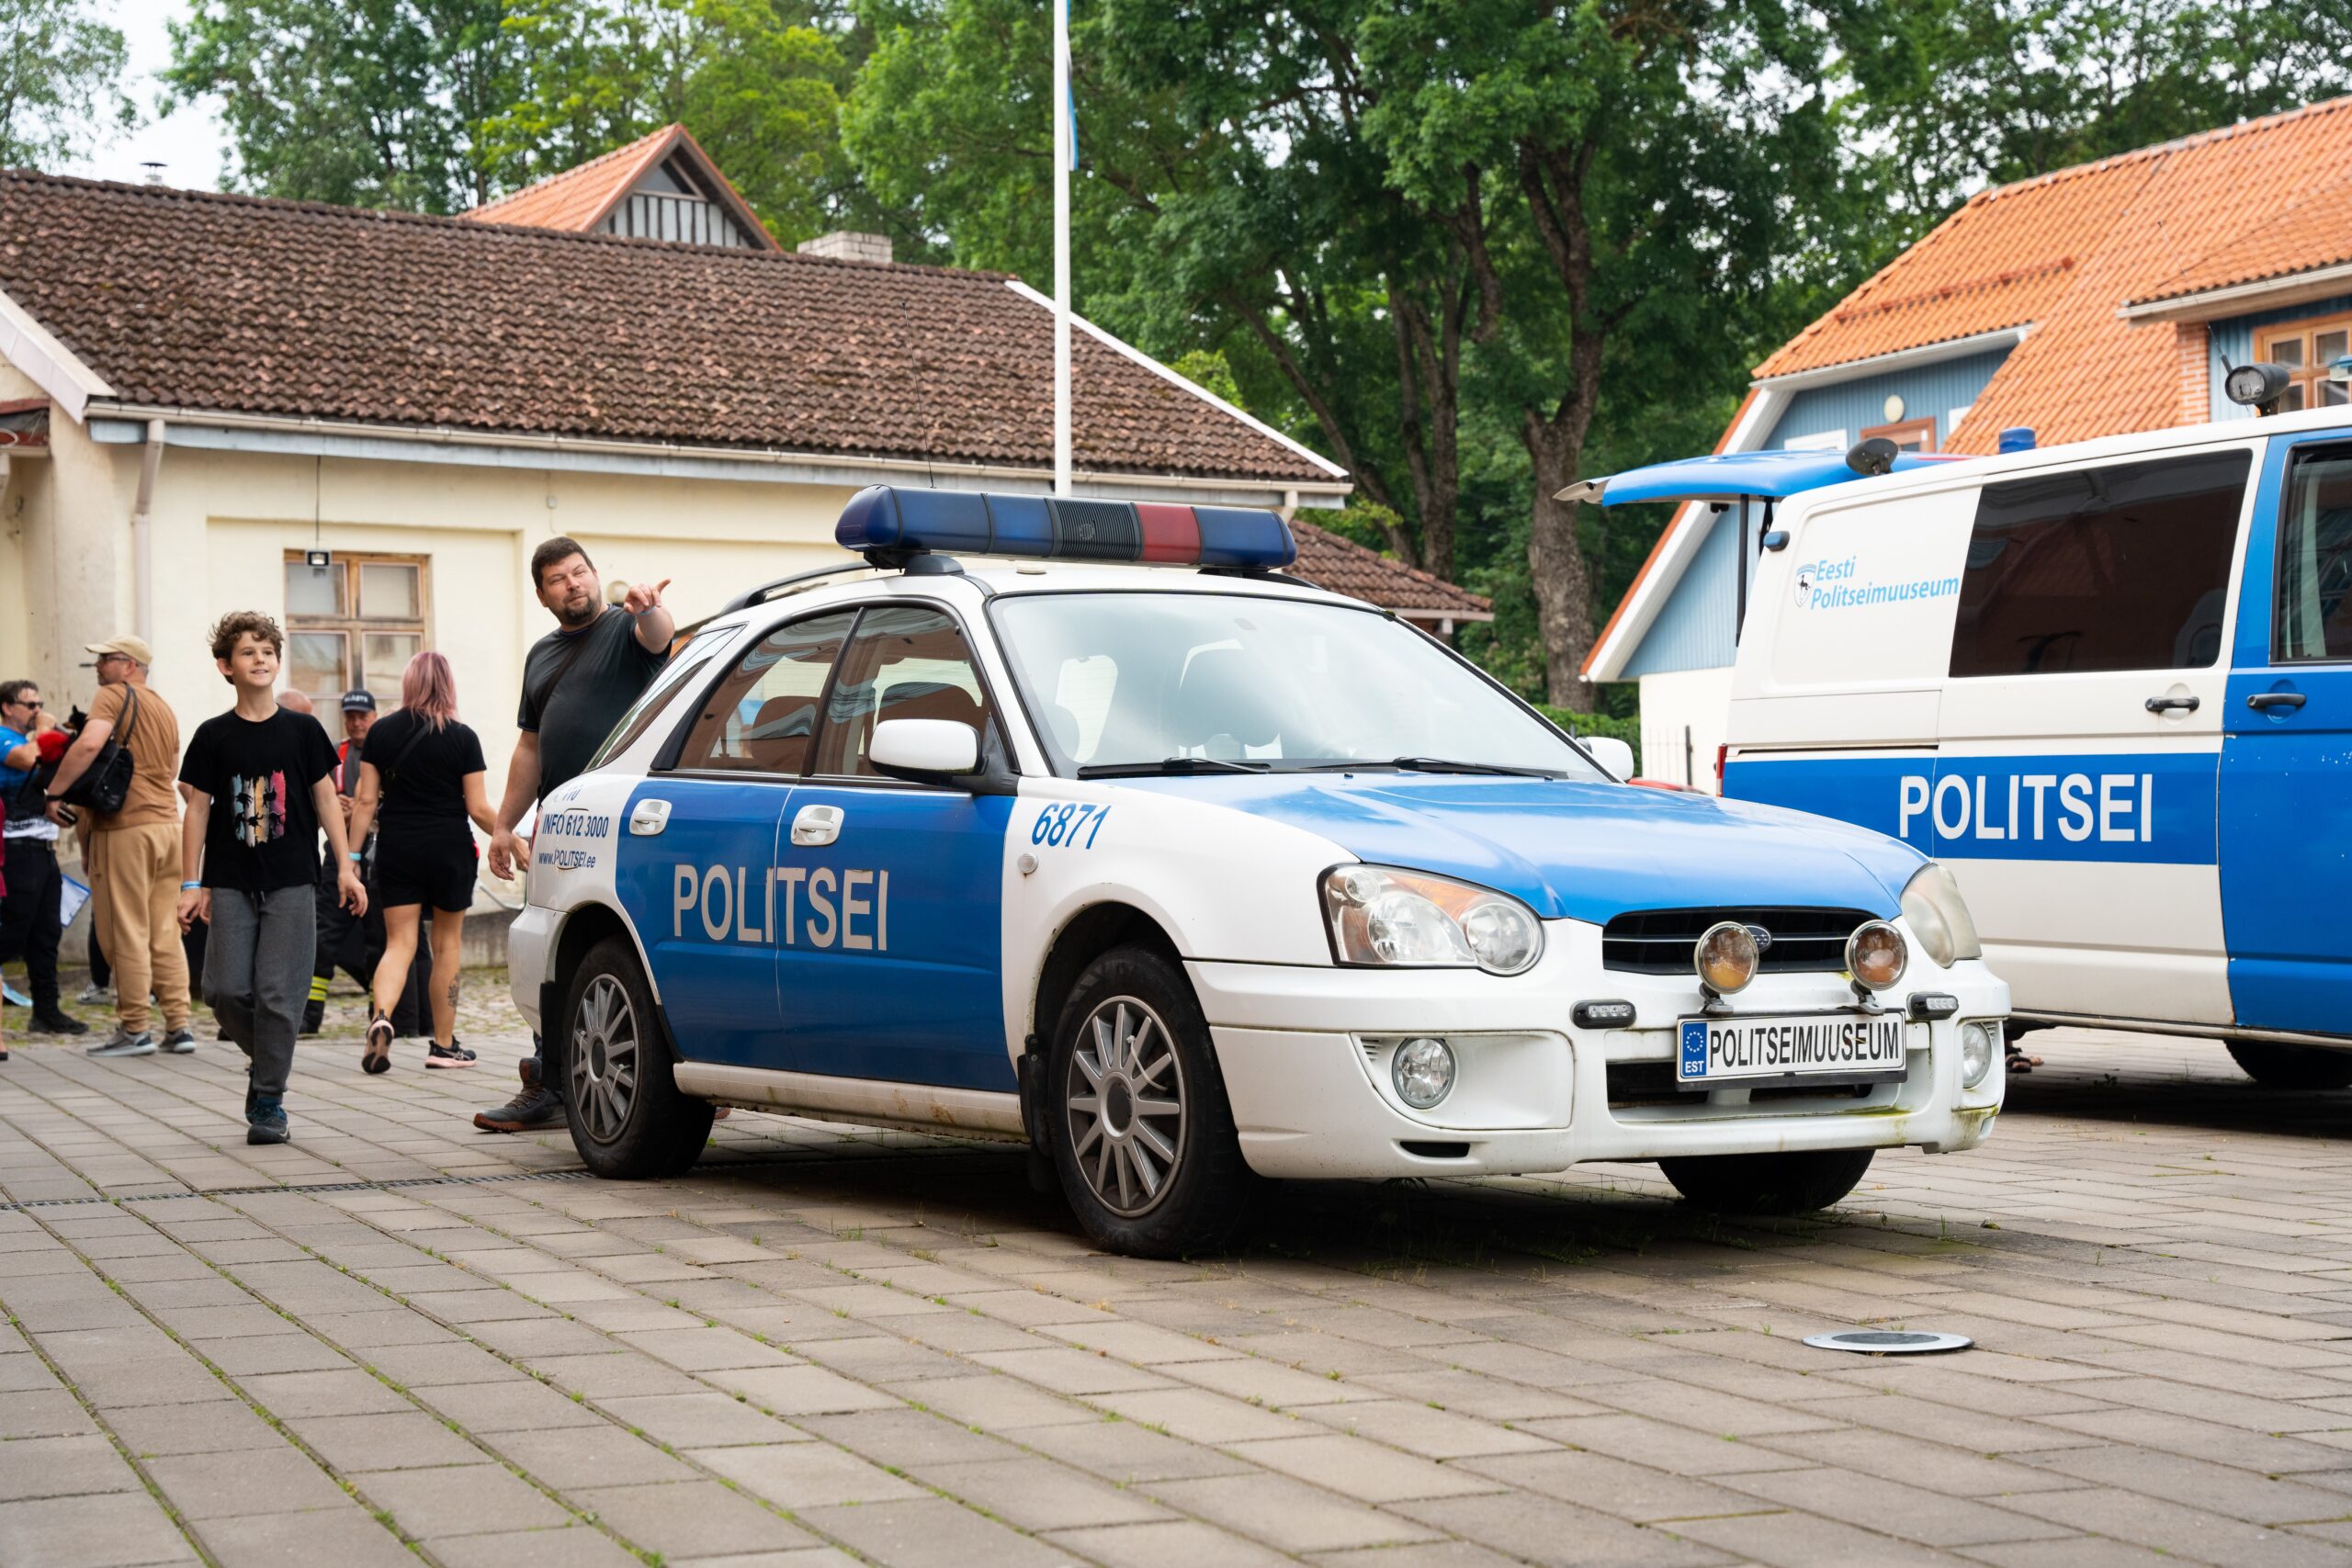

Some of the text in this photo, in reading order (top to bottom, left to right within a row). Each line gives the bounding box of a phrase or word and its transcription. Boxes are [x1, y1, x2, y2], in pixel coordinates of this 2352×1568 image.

[1815, 556, 1857, 581] Eesti
[1811, 577, 1959, 610] Politseimuuseum
[1899, 773, 2154, 842] POLITSEI
[542, 814, 609, 838] INFO 612 3000
[1032, 802, 1112, 850] 6871
[538, 848, 596, 868] www.POLITSEI.ee
[673, 863, 888, 951] POLITSEI
[1710, 1021, 1899, 1068] POLITSEIMUUSEUM
[1685, 1060, 1704, 1074] EST
